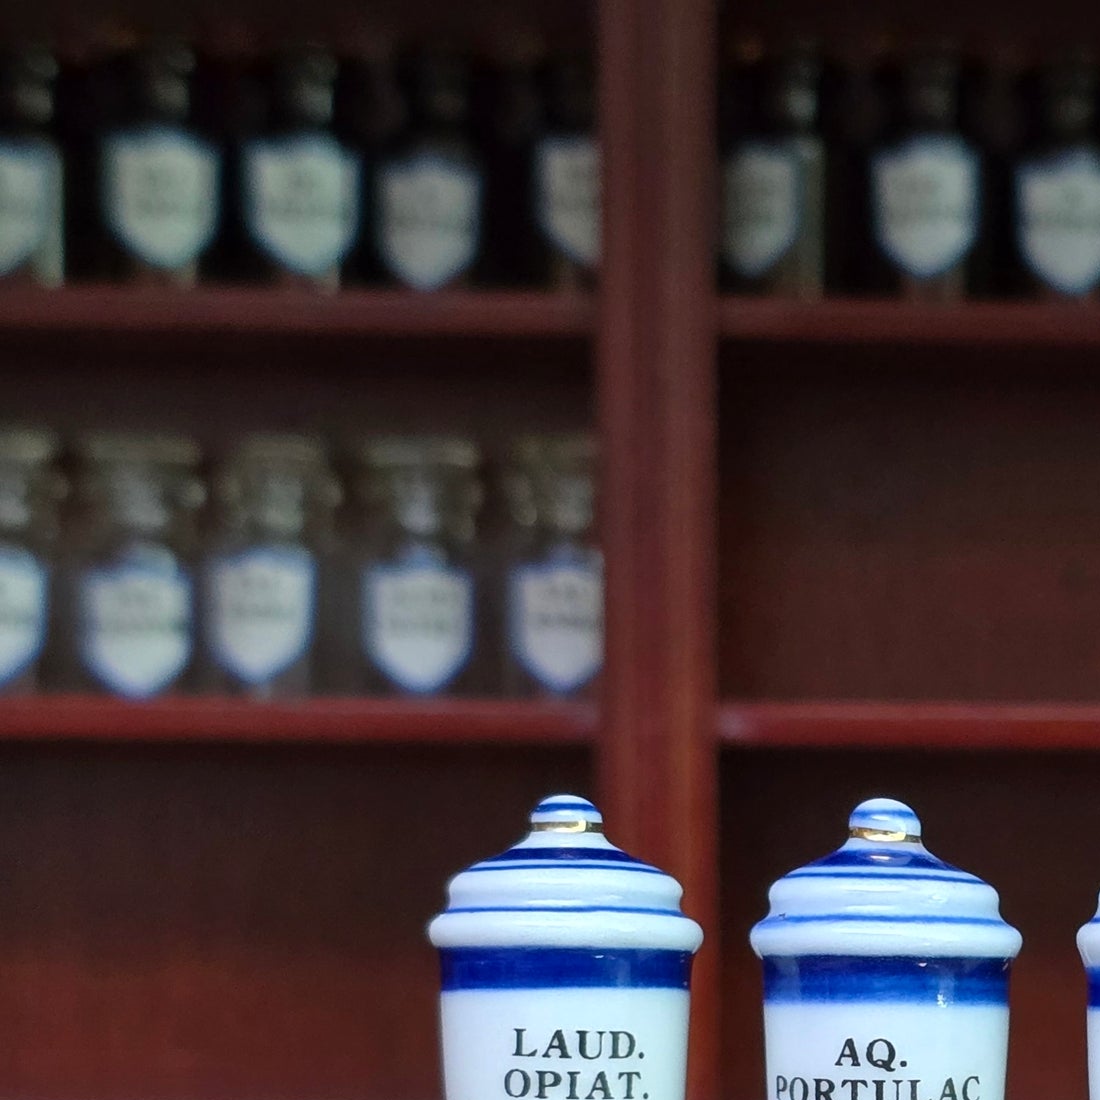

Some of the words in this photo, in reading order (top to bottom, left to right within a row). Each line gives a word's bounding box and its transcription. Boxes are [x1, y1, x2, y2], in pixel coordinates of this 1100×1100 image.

[512, 1028, 645, 1060] LAUD.
[834, 1037, 908, 1073] AQ.
[503, 1068, 649, 1100] OPIAT.
